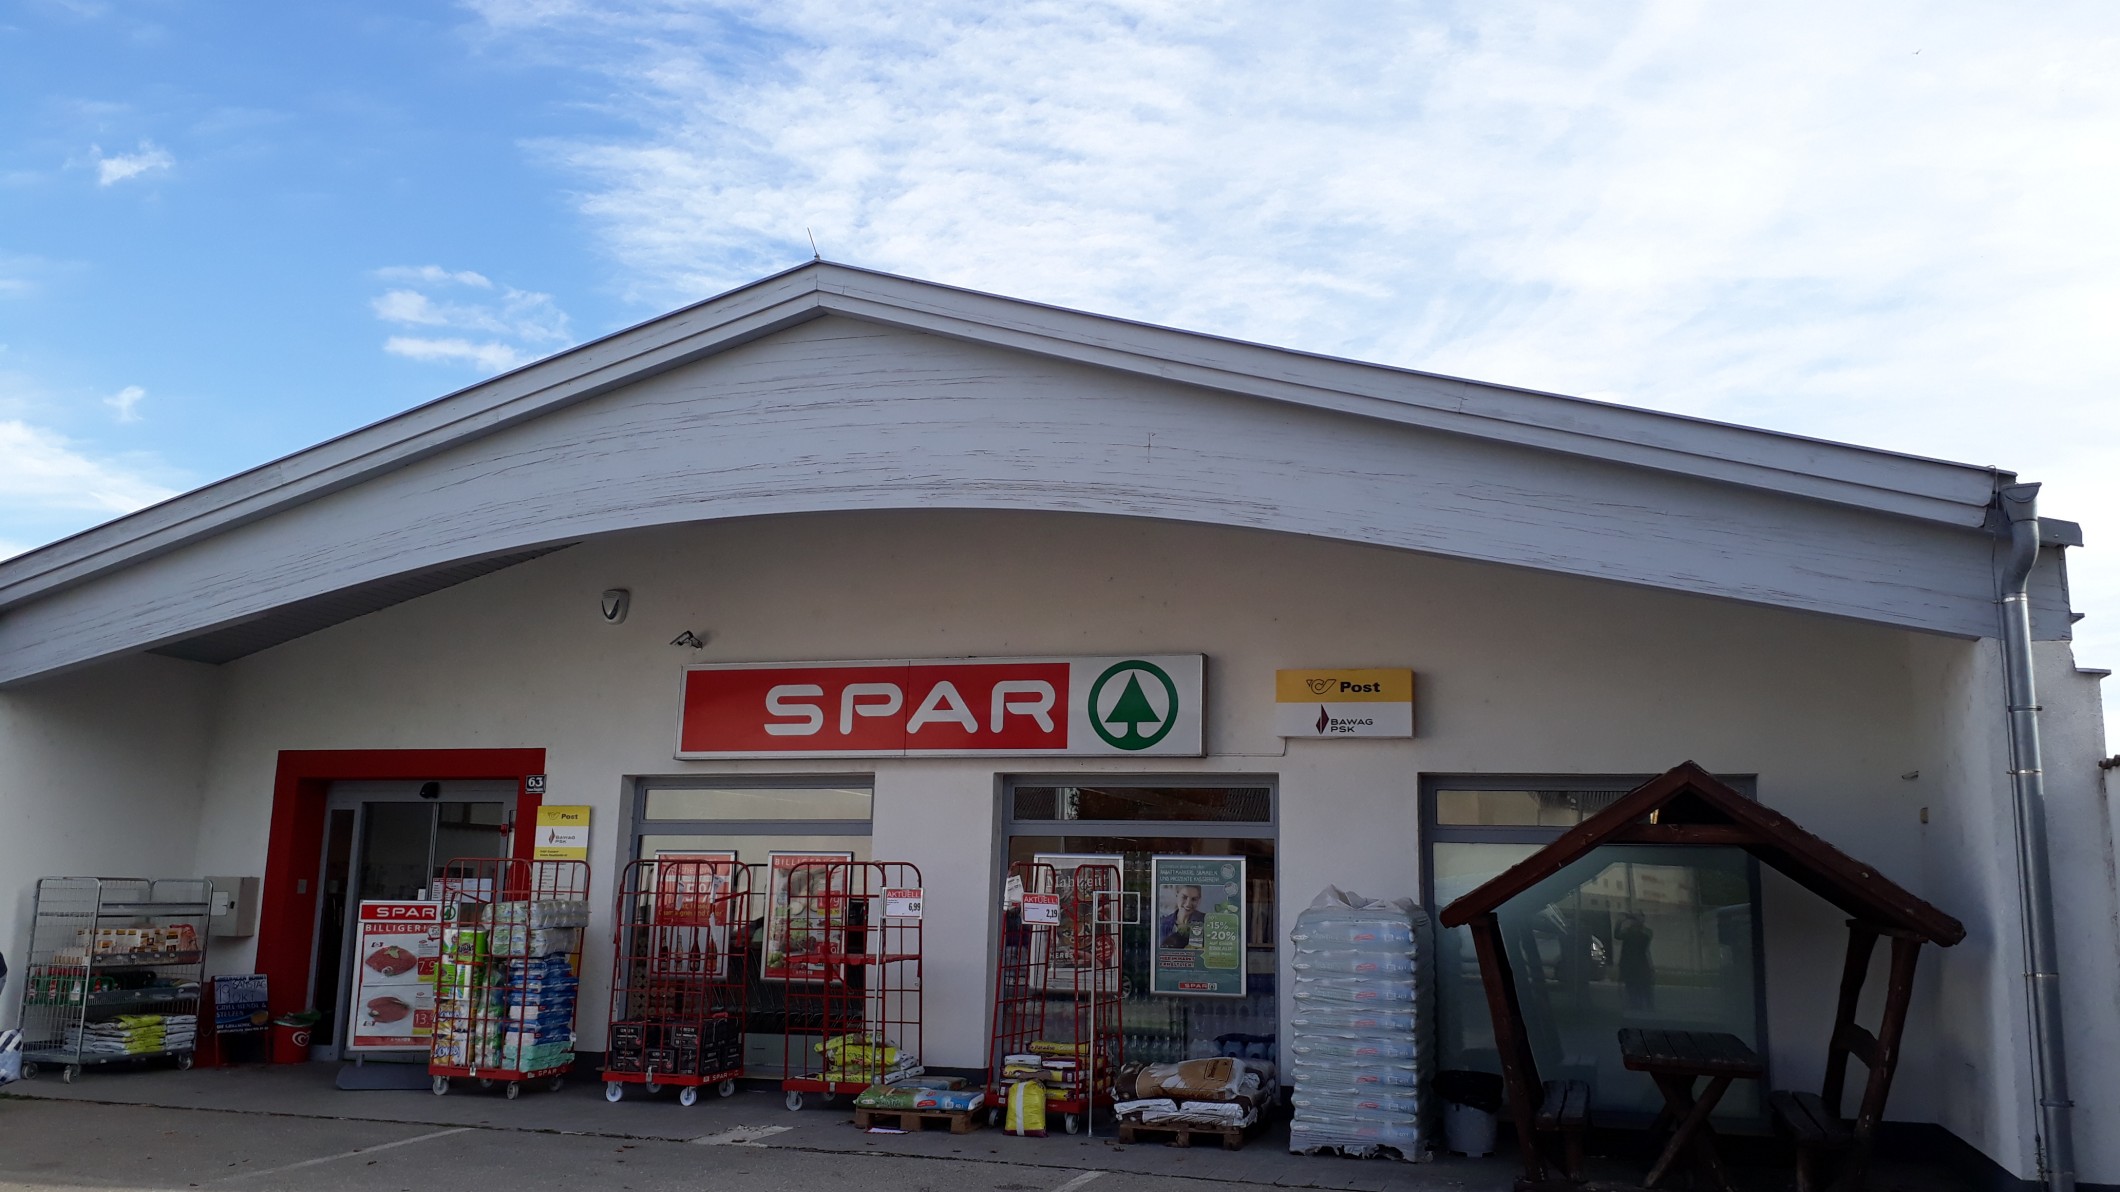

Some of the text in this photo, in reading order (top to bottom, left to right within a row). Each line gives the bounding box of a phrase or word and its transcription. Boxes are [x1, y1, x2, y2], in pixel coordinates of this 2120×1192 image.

[1340, 681, 1381, 693] Post
[764, 681, 1055, 735] SPAR
[1331, 718, 1374, 726] BAWAG
[527, 776, 543, 788] 63
[376, 907, 435, 918] SPAR
[908, 902, 921, 912] 6,99
[1046, 908, 1058, 919] 2,19
[1206, 931, 1236, 941] -20%
[712, 1073, 728, 1081] SPAR
